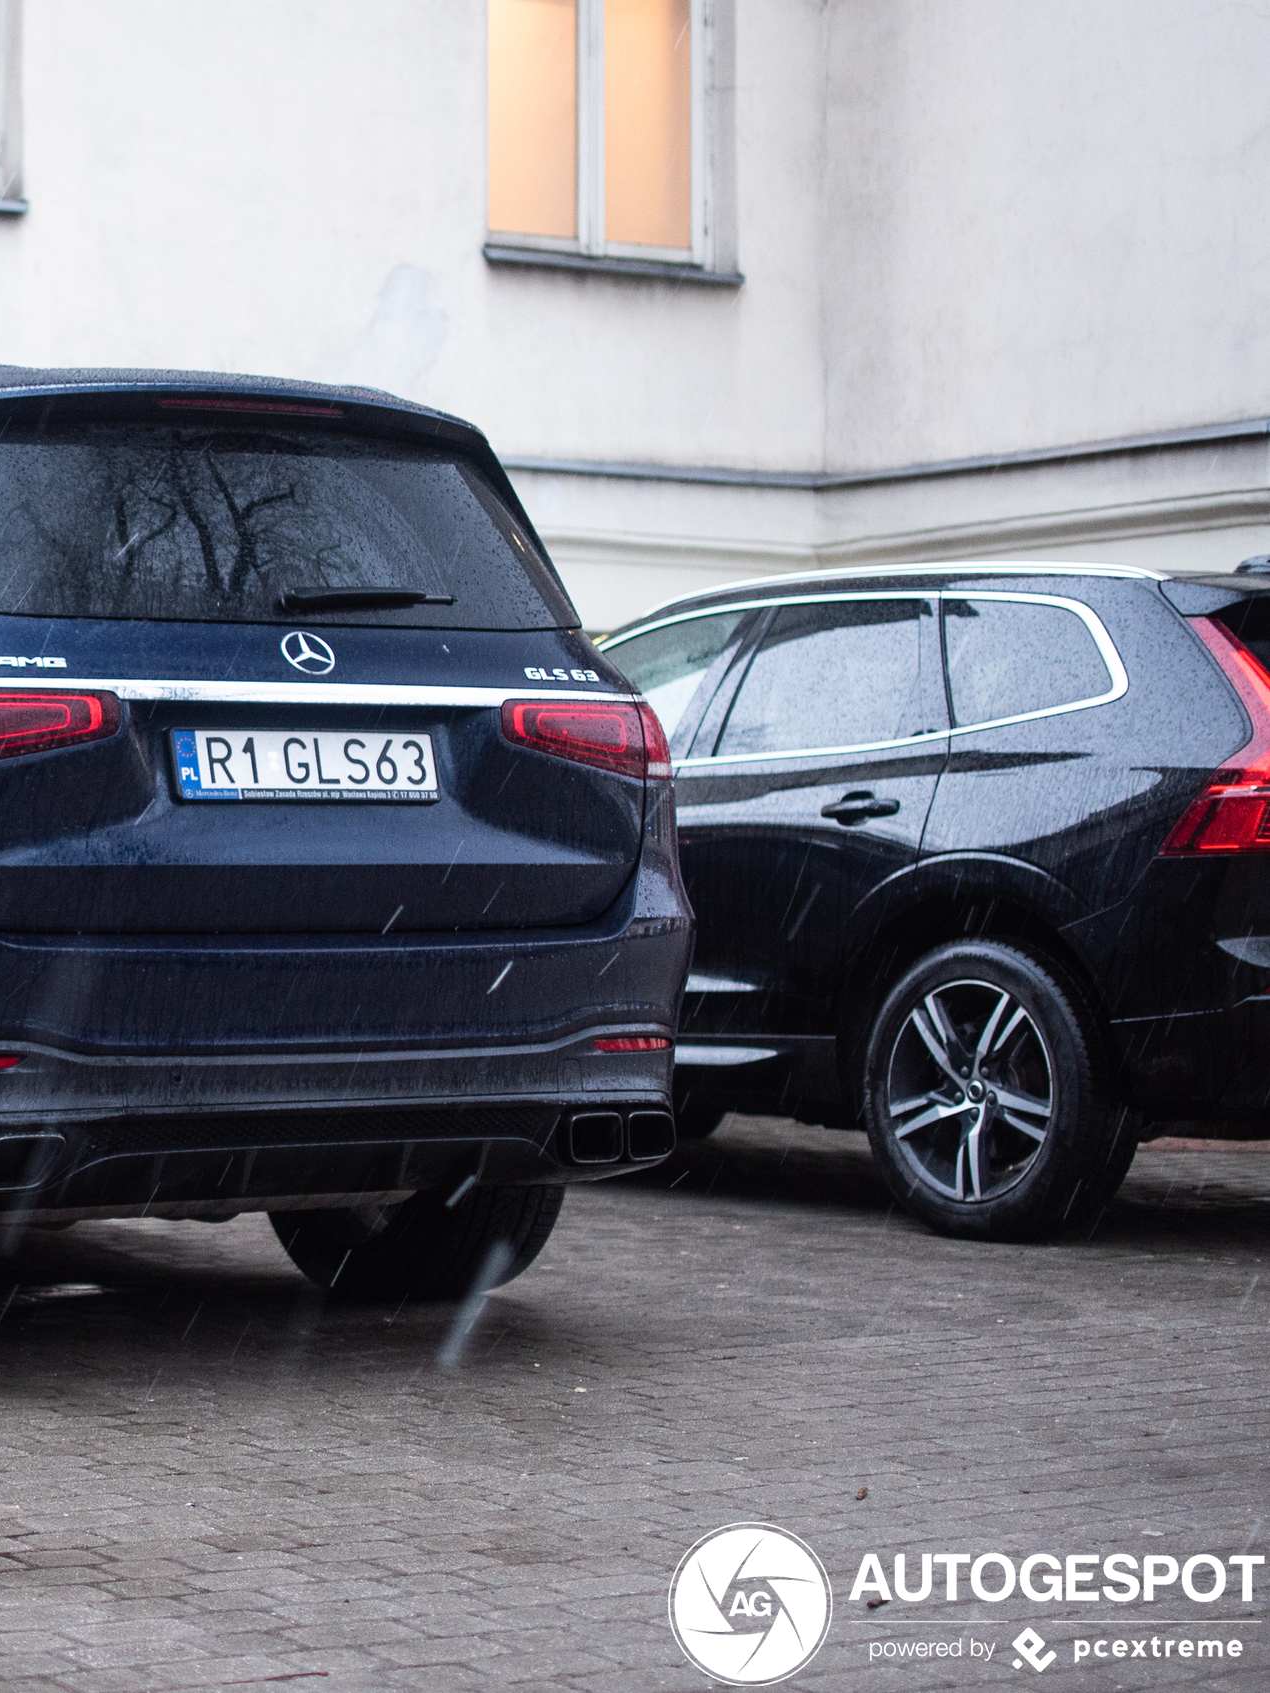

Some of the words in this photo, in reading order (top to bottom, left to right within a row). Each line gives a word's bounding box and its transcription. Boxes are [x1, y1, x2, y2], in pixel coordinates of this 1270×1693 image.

[524, 667, 569, 681] GLS
[570, 669, 600, 682] 63
[205, 736, 259, 784] R1
[283, 737, 427, 785] GLS63
[181, 767, 199, 781] PL
[275, 790, 296, 798] Zasada
